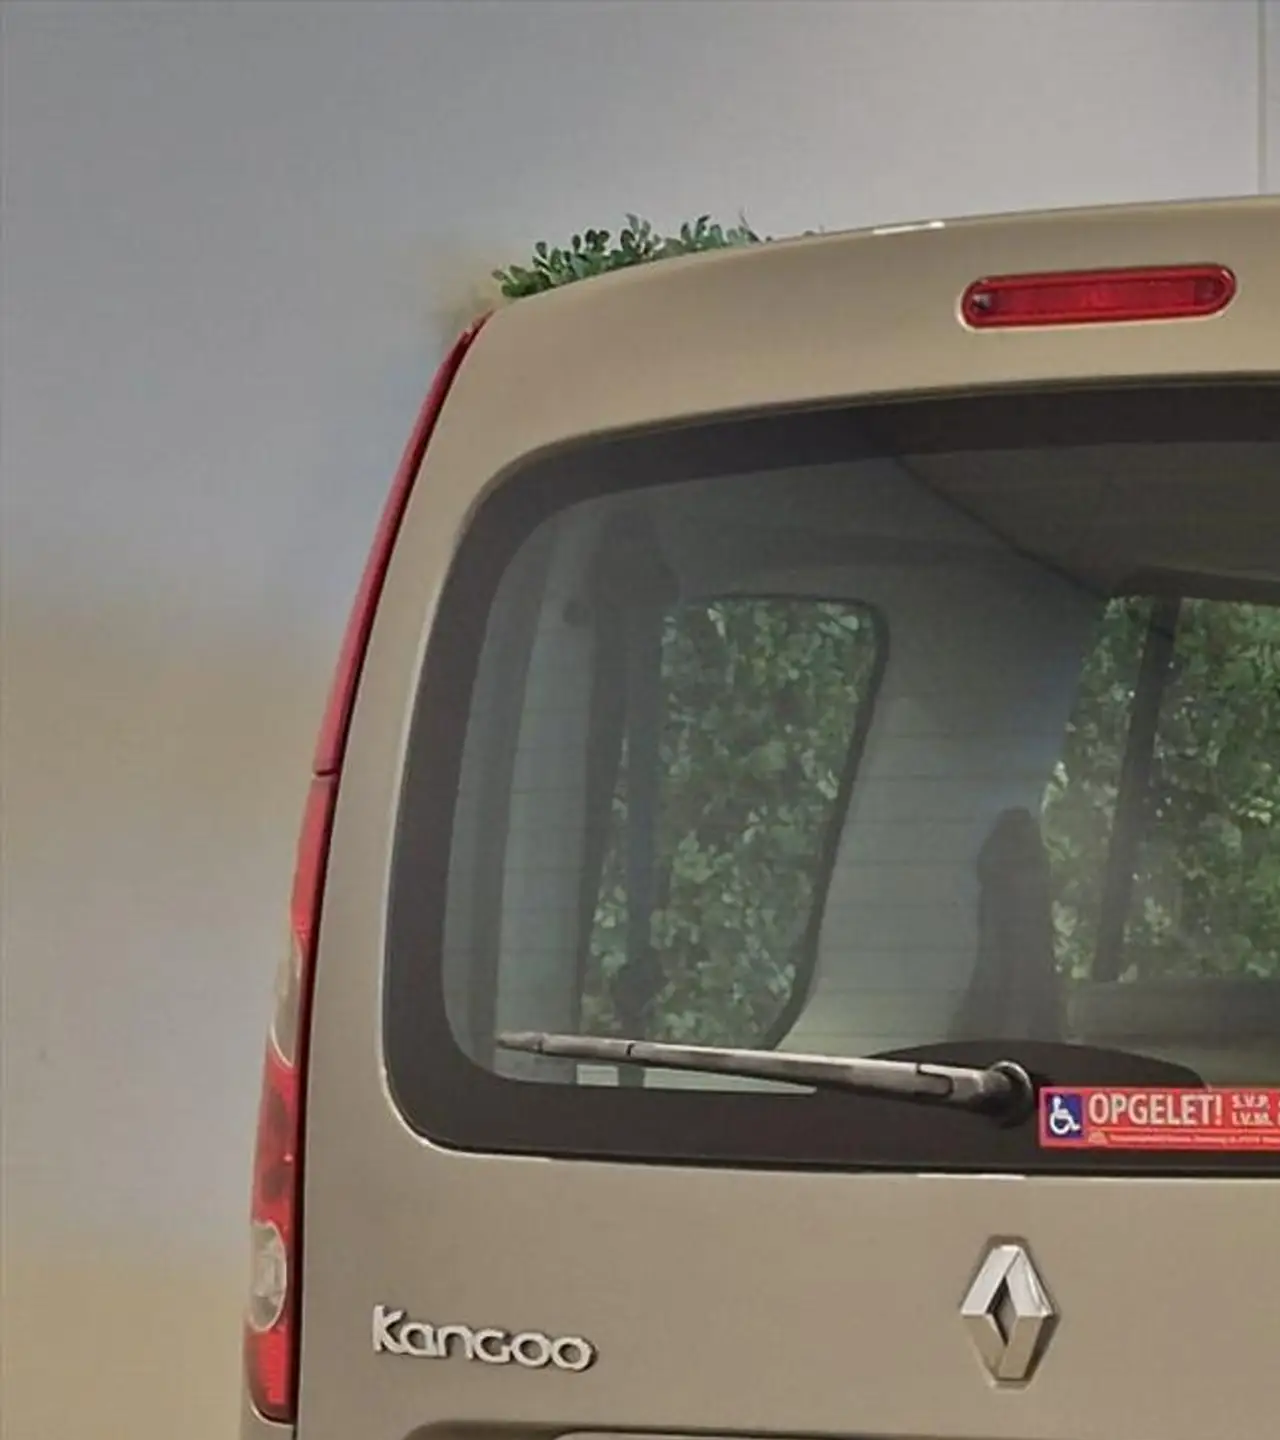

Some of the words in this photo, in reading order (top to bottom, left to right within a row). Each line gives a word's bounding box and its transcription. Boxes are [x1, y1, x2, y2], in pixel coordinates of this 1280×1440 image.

[1088, 1093, 1222, 1125] OPGELET!
[1231, 1094, 1270, 1109] S.V.P.
[372, 1304, 598, 1373] Kangoo
